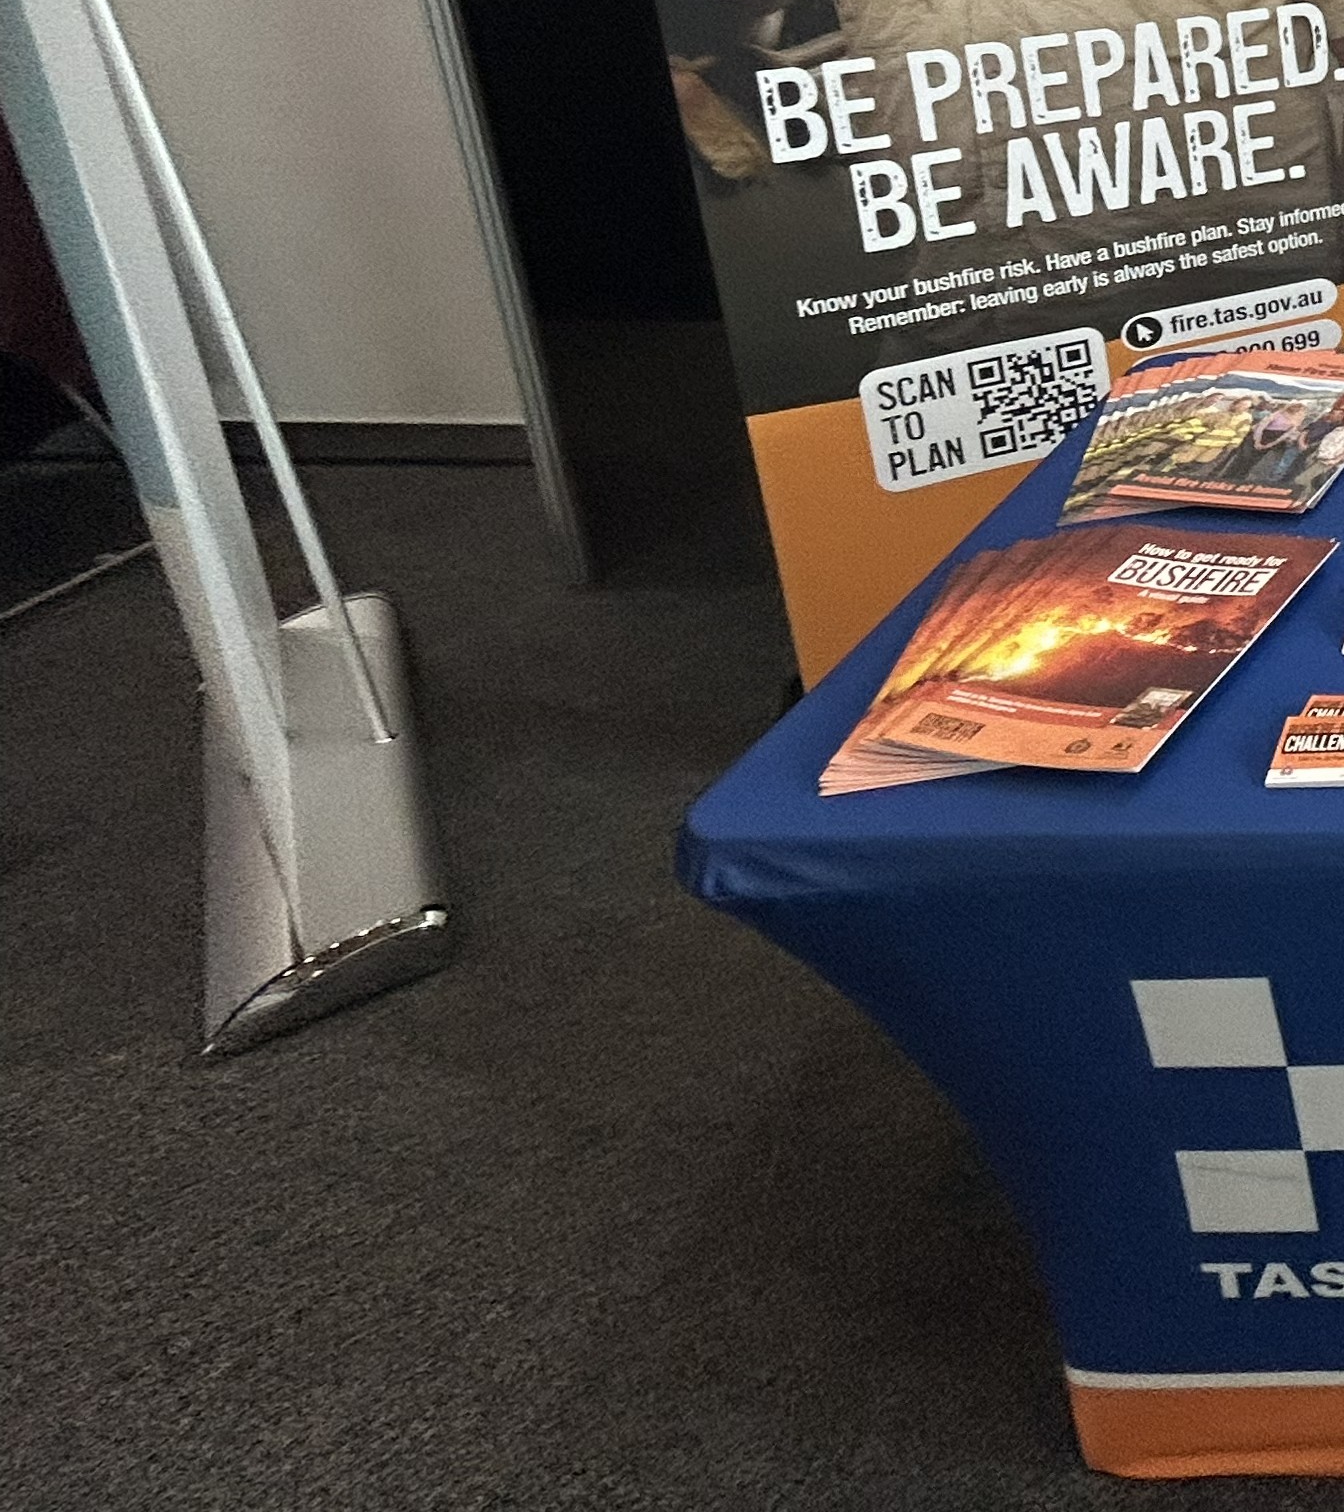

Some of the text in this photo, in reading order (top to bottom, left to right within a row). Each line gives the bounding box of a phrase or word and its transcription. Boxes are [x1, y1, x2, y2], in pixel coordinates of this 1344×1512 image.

[755, 57, 892, 163] BE
[850, 100, 1305, 253] BE AWARE.
[796, 294, 857, 317] Know
[862, 283, 910, 309] your
[913, 266, 995, 296] bushfire
[1000, 259, 1041, 280] risk.
[1045, 249, 1092, 271] Have
[1097, 246, 1110, 261] a
[1113, 230, 1187, 259] bushfire
[1192, 223, 1232, 247] plan.
[1236, 215, 1275, 236] Stay
[848, 230, 1323, 336] Remember: leaving early is always the safest option.
[1170, 289, 1323, 334] fire.tas.gov.au
[1282, 329, 1321, 352] 699
[877, 368, 957, 411] SCAN
[881, 411, 926, 445] TO
[888, 437, 967, 482] PLAN
[1115, 558, 1271, 593] BUSHFIRE
[1138, 542, 1288, 567] How to get ready for
